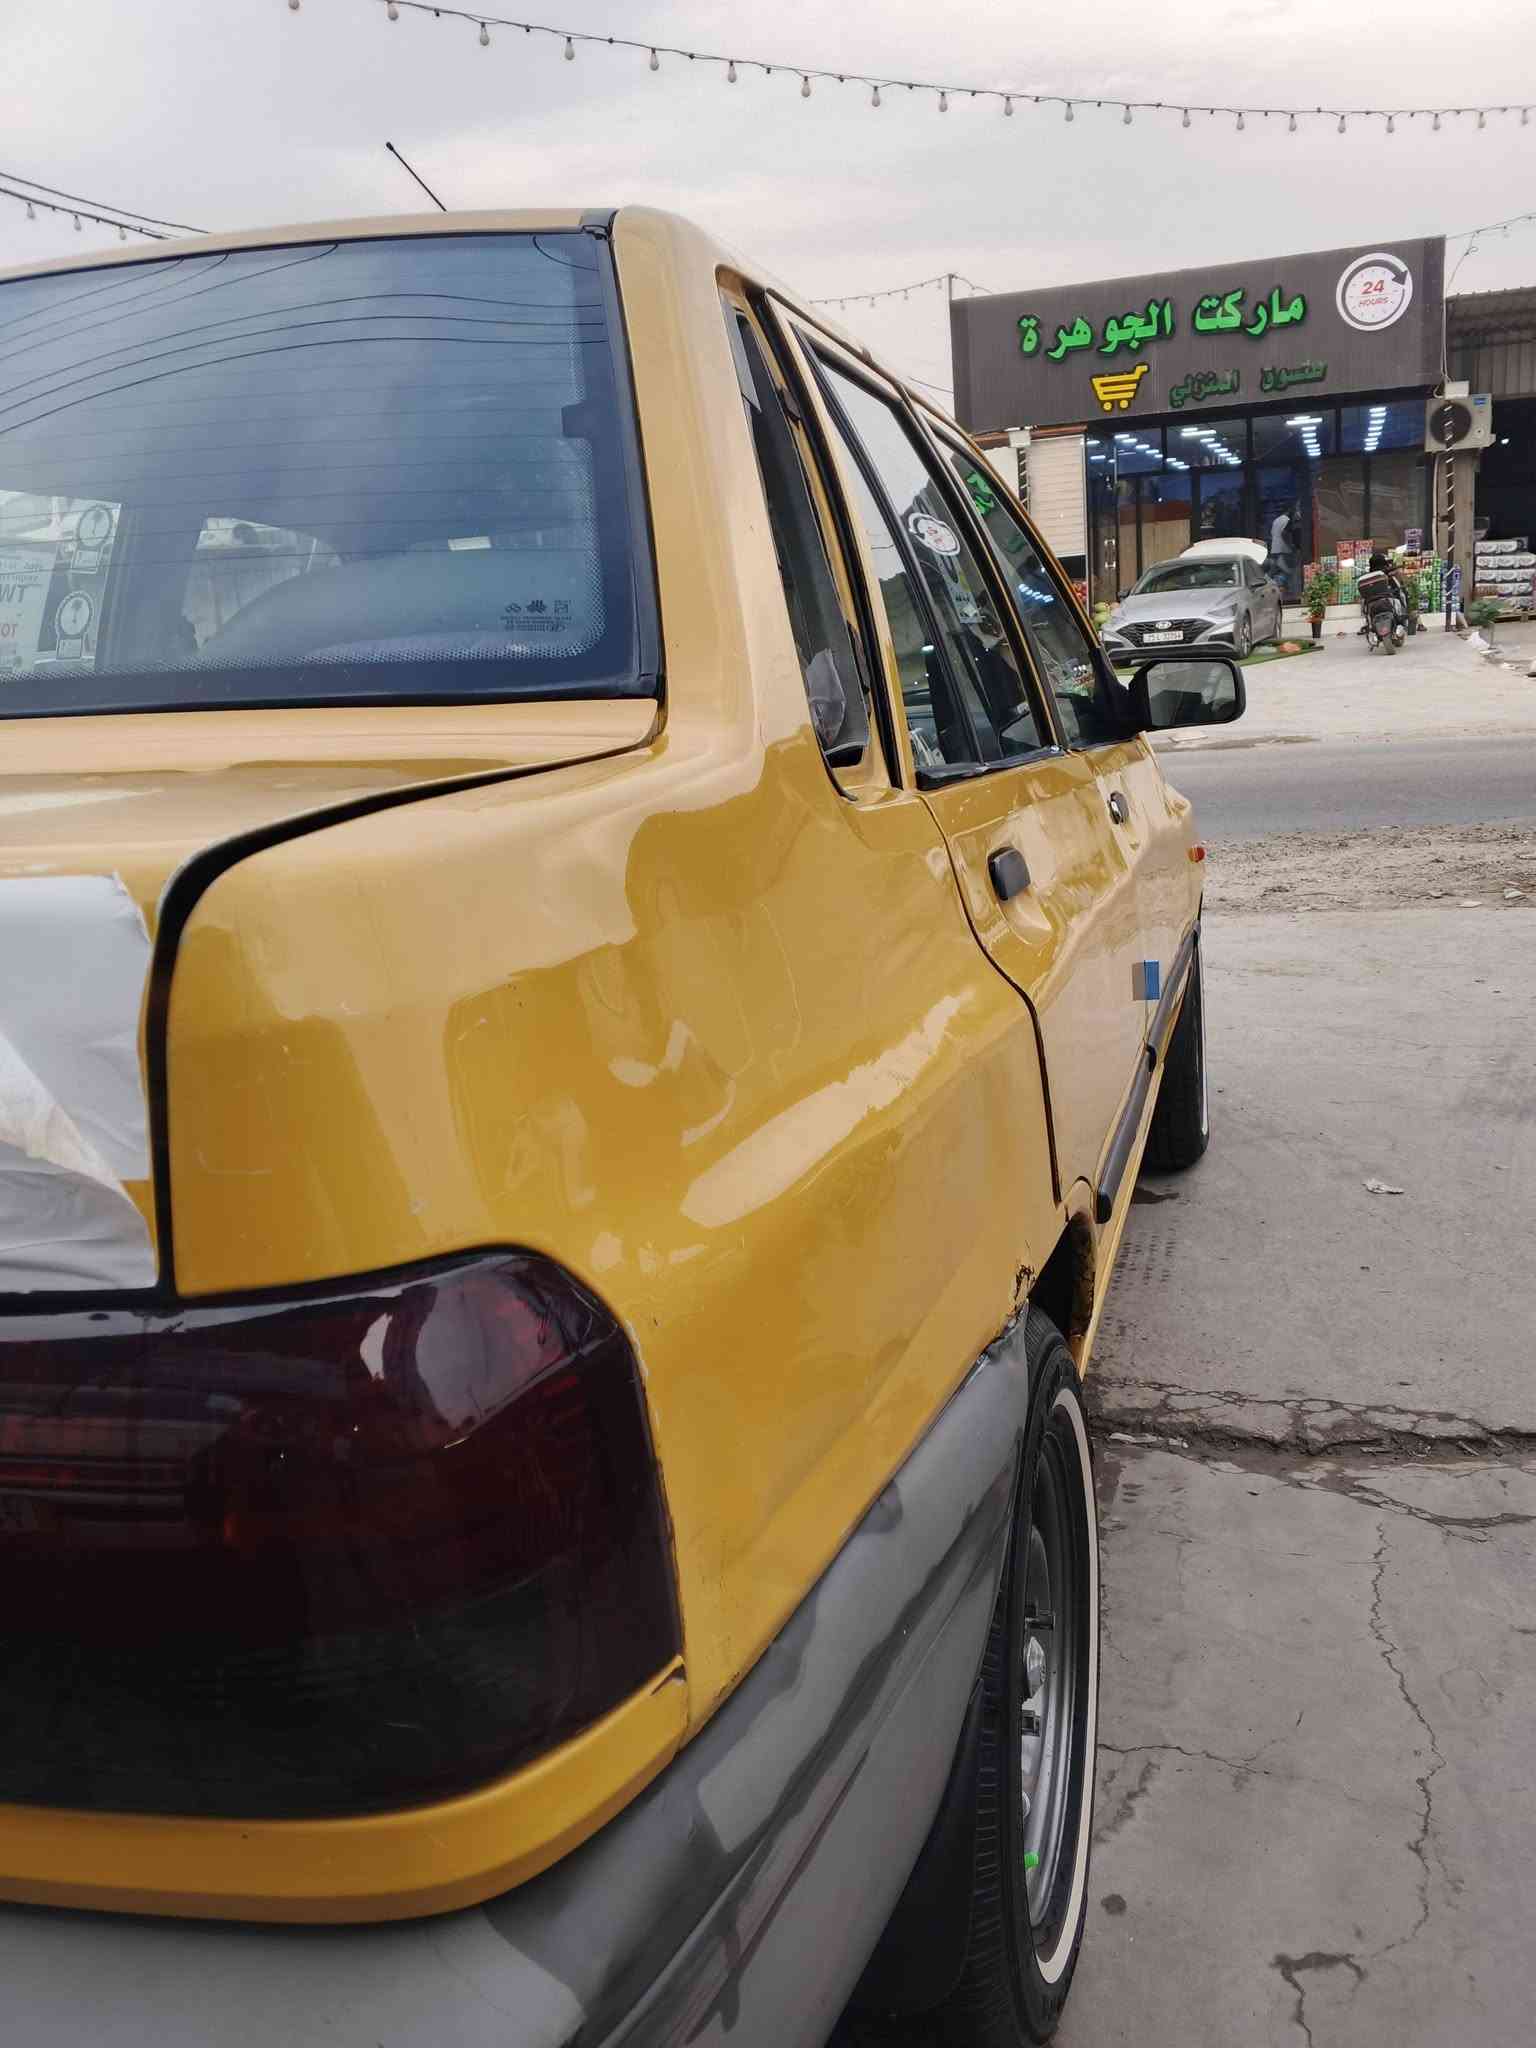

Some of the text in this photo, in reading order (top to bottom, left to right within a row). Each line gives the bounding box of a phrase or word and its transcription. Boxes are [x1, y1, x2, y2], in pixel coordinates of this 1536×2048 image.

[1362, 279, 1385, 295] 24
[1018, 287, 1305, 360] ماركت الجوهرة
